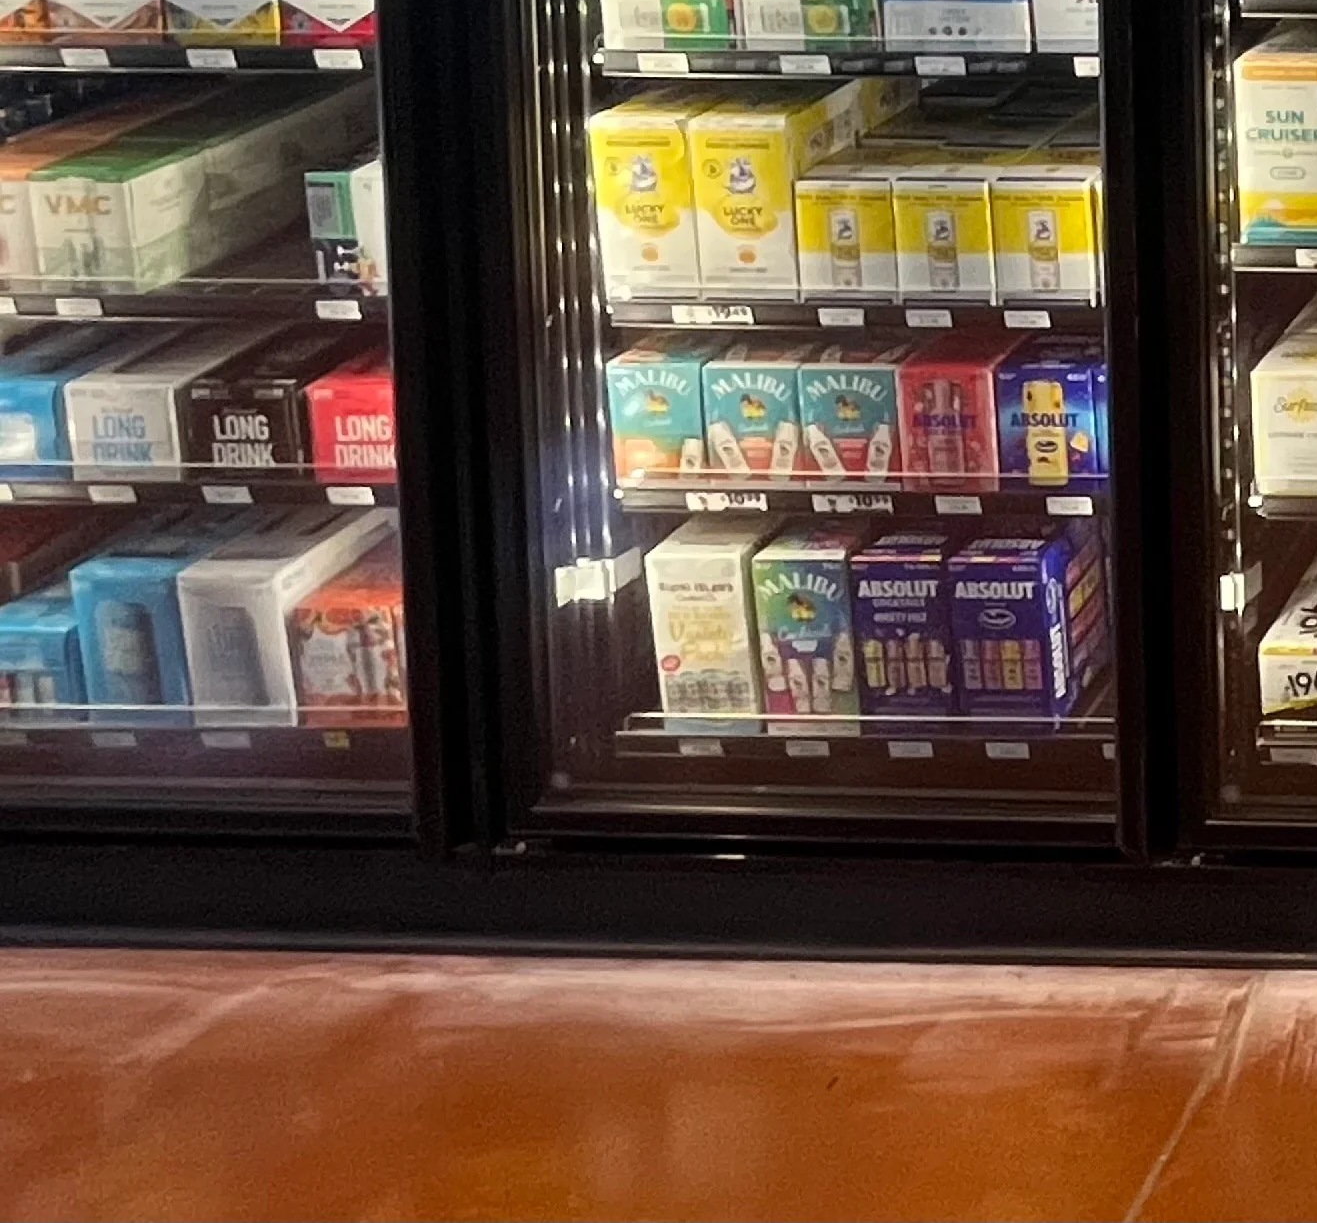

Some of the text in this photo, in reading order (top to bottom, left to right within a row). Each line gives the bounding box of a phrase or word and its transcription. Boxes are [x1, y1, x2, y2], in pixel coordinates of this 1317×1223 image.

[1265, 111, 1304, 125] SUN
[46, 195, 111, 215] VMC
[625, 204, 666, 216] LUCKY
[723, 207, 763, 217] LUCKY
[632, 216, 657, 225] ONE
[730, 217, 755, 227] ONE
[615, 369, 691, 396] MALIBU
[711, 371, 791, 398] MALIBU
[806, 373, 888, 399] MALIBU
[92, 415, 145, 440] LONG
[214, 415, 268, 440] LONG
[336, 415, 390, 442] LONG
[912, 414, 976, 428] ABSOLUT
[1010, 413, 1077, 428] ABSOLUT
[213, 443, 273, 467] DRINK
[760, 571, 842, 602] MALIBU
[857, 580, 938, 598] ABSOLUT
[955, 581, 1034, 599] ABSOLUT
